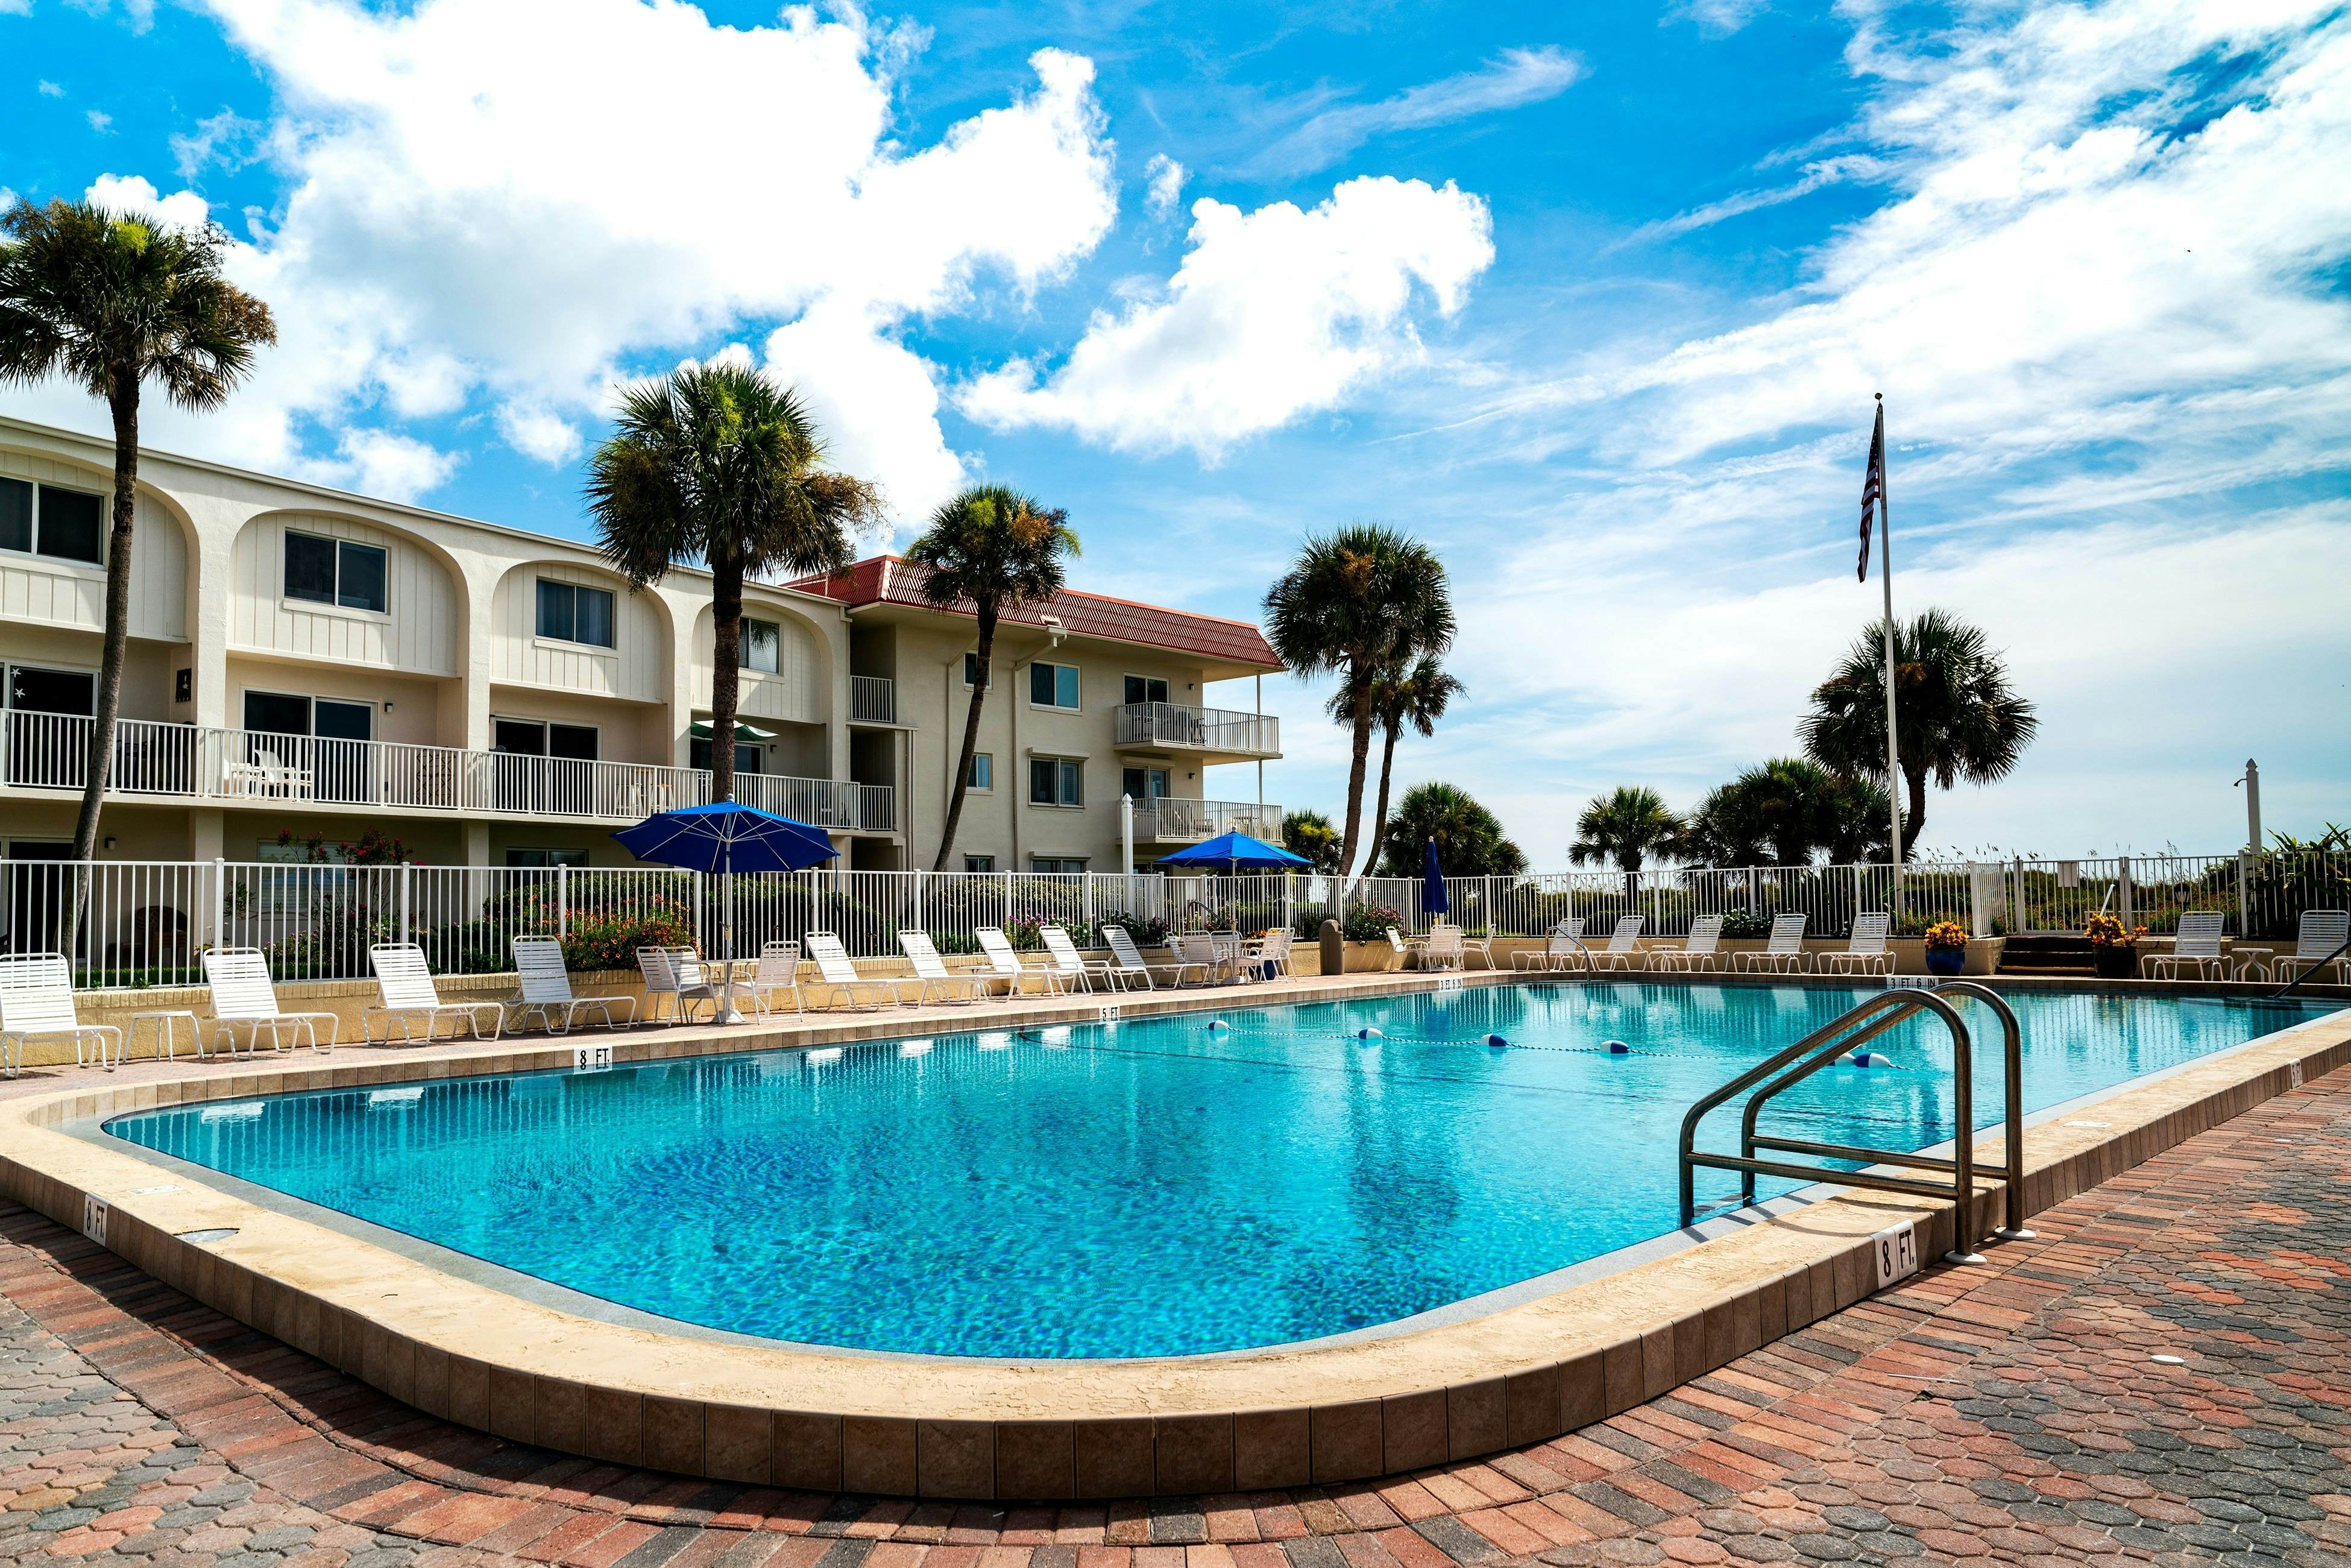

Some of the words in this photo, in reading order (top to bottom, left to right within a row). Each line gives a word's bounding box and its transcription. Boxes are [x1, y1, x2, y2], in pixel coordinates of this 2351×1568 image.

[1891, 978, 1895, 986] 3
[1917, 978, 1921, 986] 6
[1103, 1008, 1106, 1018] 5
[580, 1050, 587, 1065] 8
[596, 1048, 609, 1063] FT.
[87, 1201, 91, 1231] 8
[95, 1204, 104, 1238] FT.
[1883, 1240, 1891, 1277] 8
[1898, 1229, 1915, 1269] FT.
